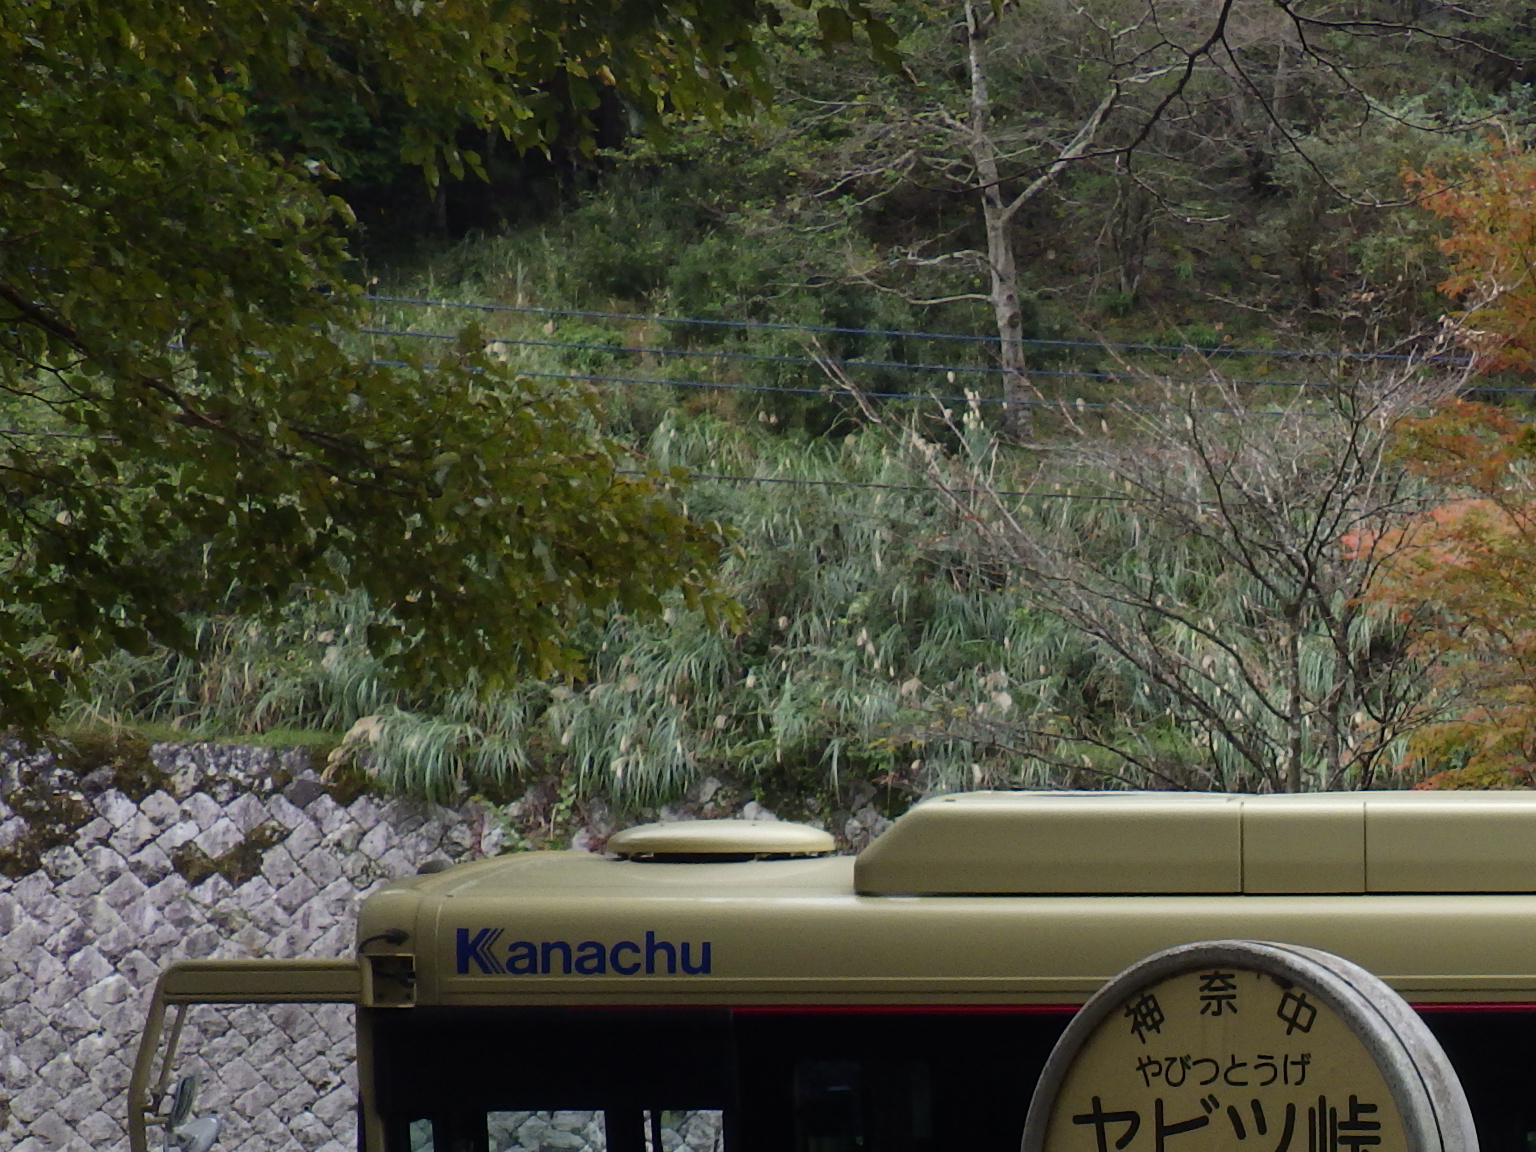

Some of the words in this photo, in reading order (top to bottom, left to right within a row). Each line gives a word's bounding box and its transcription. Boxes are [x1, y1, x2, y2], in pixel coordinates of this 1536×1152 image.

[457, 928, 711, 975] Kanachu
[1124, 970, 1318, 1044] 神奈中
[1136, 1052, 1311, 1088] やびつとうげ
